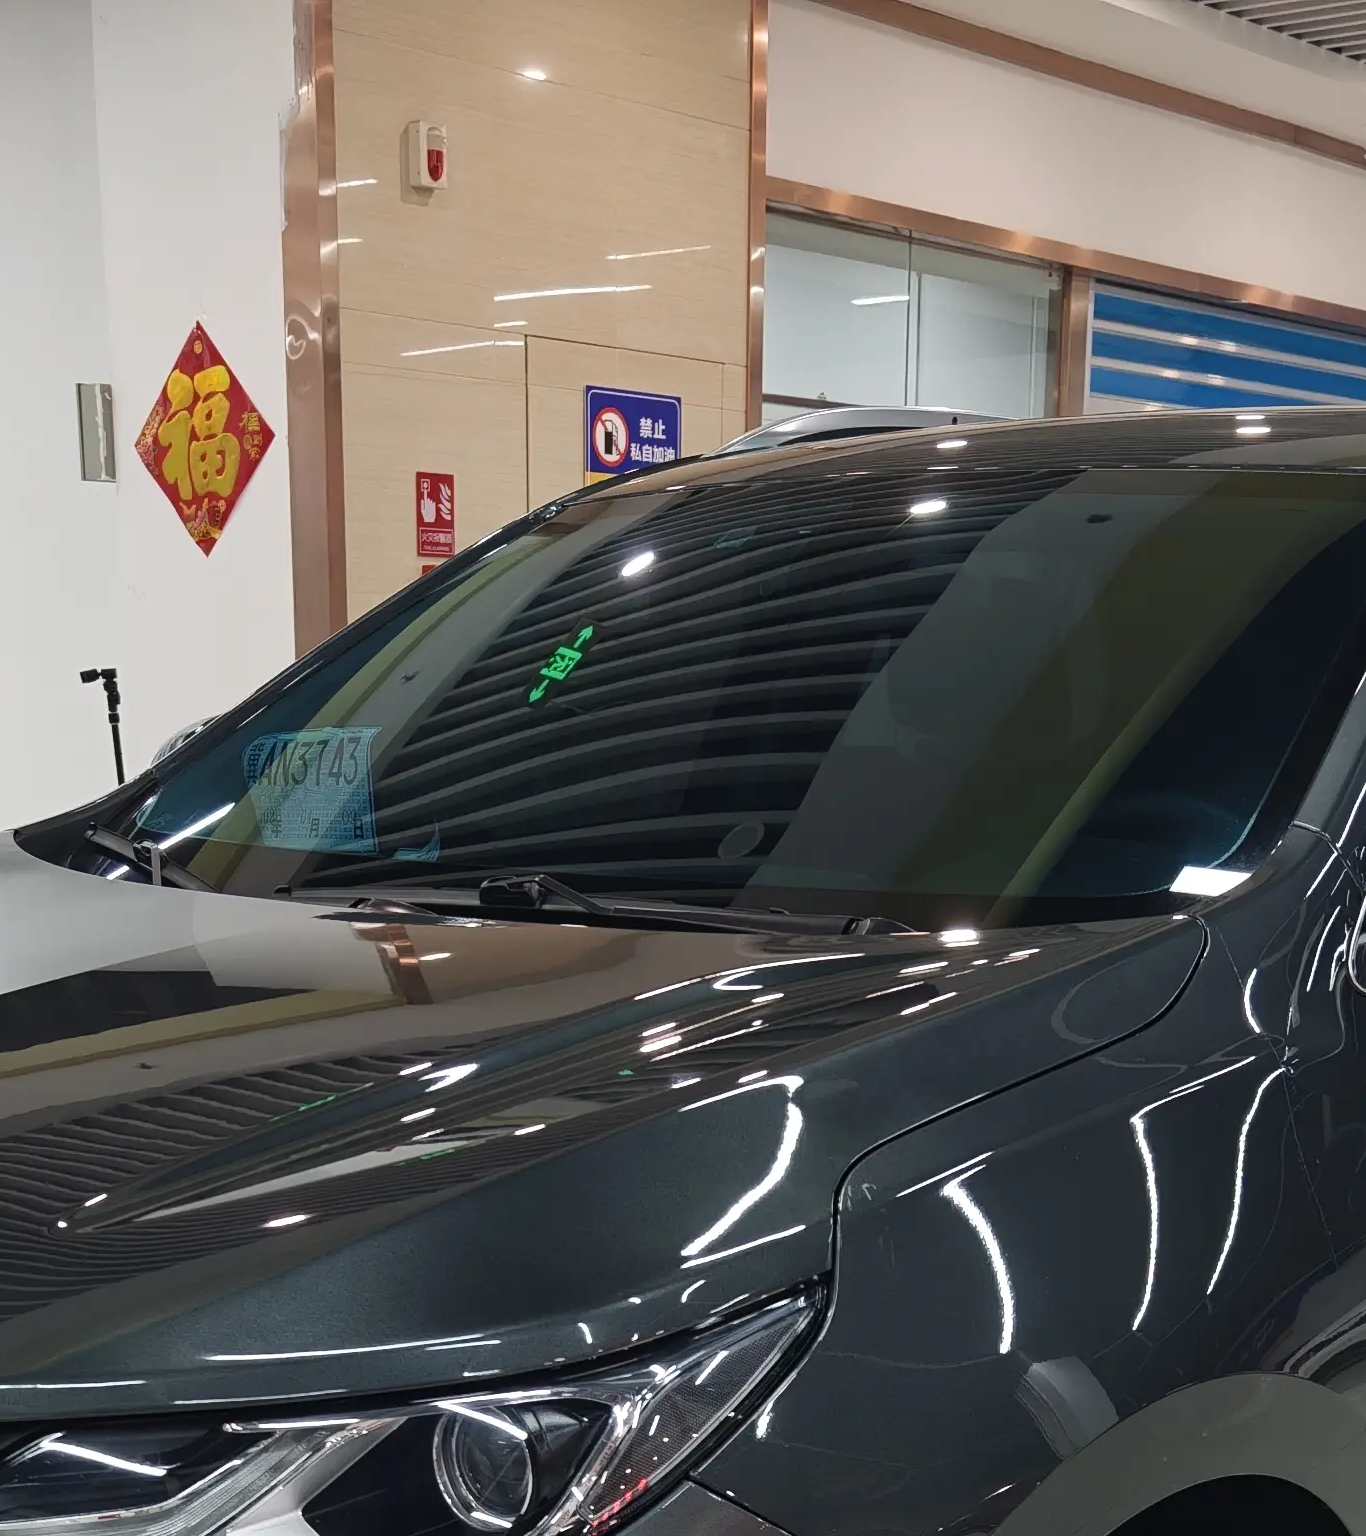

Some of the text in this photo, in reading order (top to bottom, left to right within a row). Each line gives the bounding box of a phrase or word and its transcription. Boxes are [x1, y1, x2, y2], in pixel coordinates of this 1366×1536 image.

[158, 364, 241, 500] 福
[640, 417, 666, 440] 禁止
[630, 443, 675, 463] 私自加油
